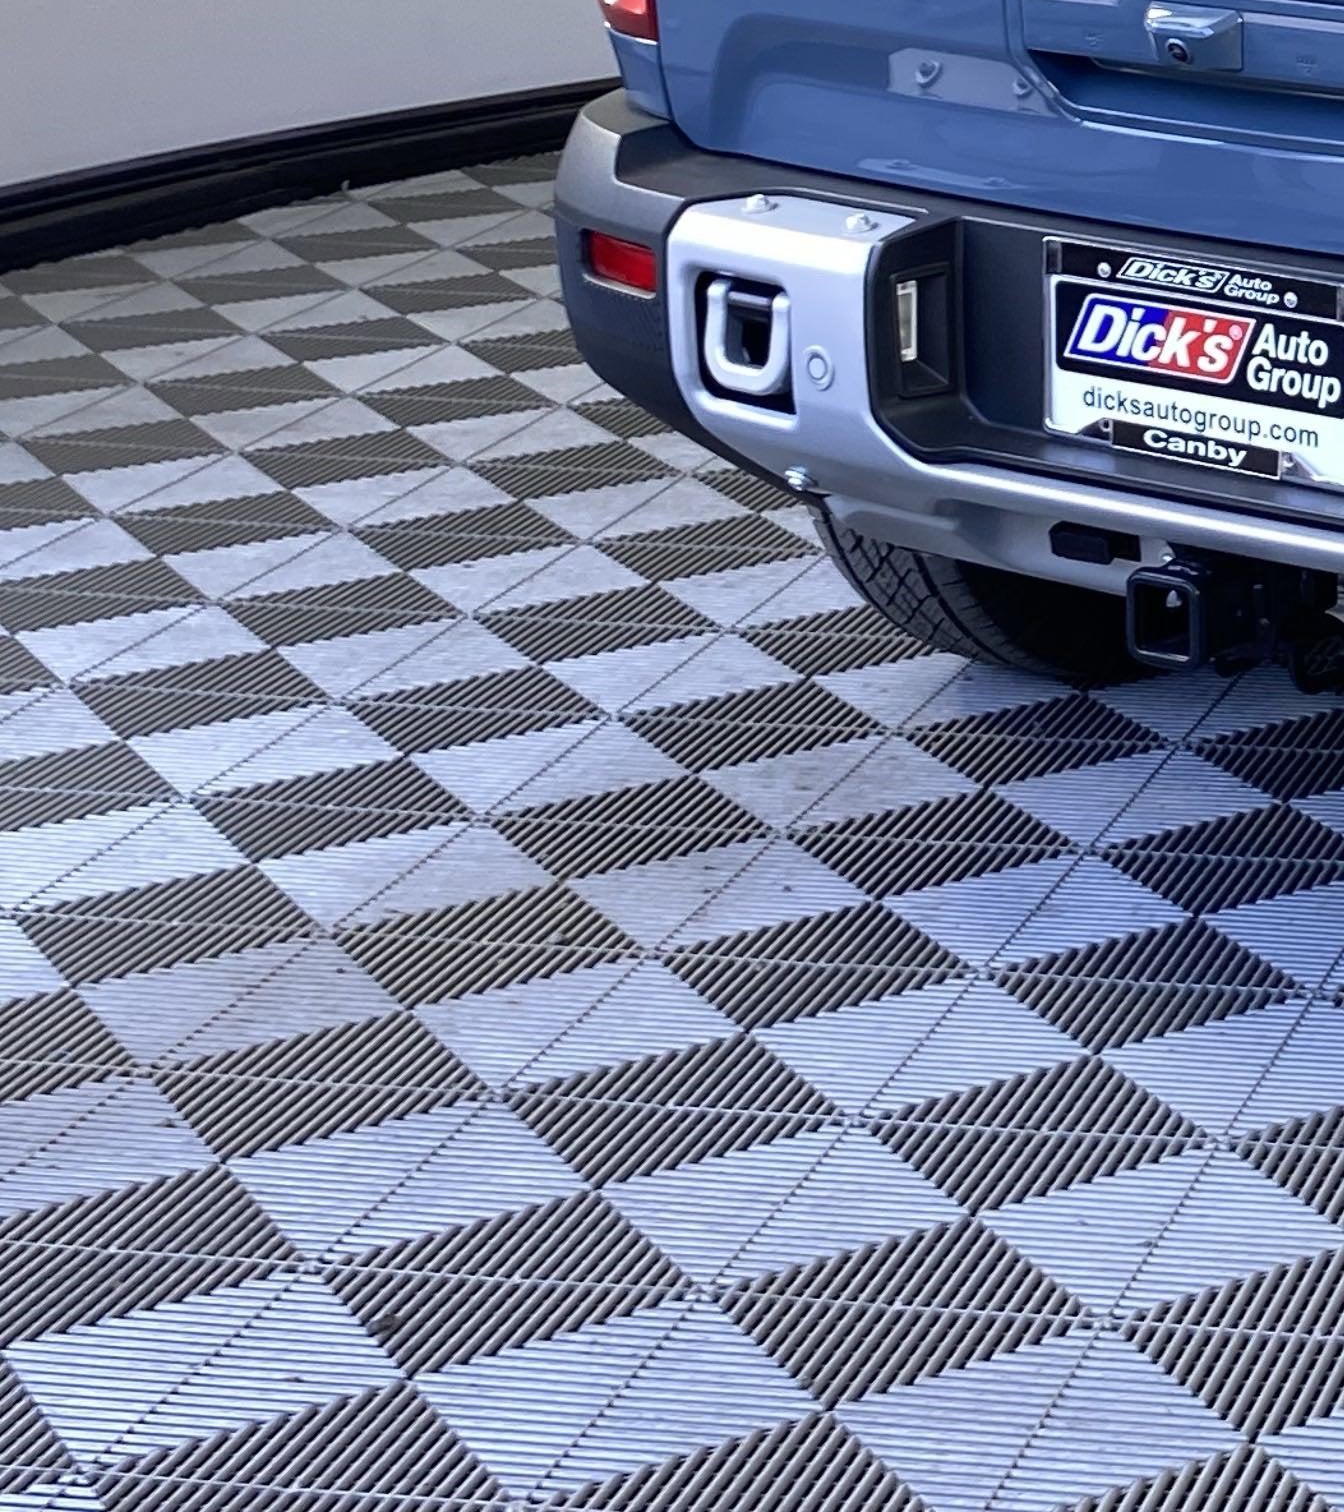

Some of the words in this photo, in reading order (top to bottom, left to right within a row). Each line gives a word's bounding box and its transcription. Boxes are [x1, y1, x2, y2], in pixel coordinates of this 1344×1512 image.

[1125, 260, 1222, 289] Dick's
[1224, 282, 1280, 305] Group
[1228, 274, 1272, 291] Auto
[1077, 303, 1235, 374] Dick's
[1252, 323, 1329, 366] Auto
[1246, 356, 1342, 409] Group
[1083, 385, 1320, 449] dicksautogroup.com
[1143, 429, 1248, 468] Canby
